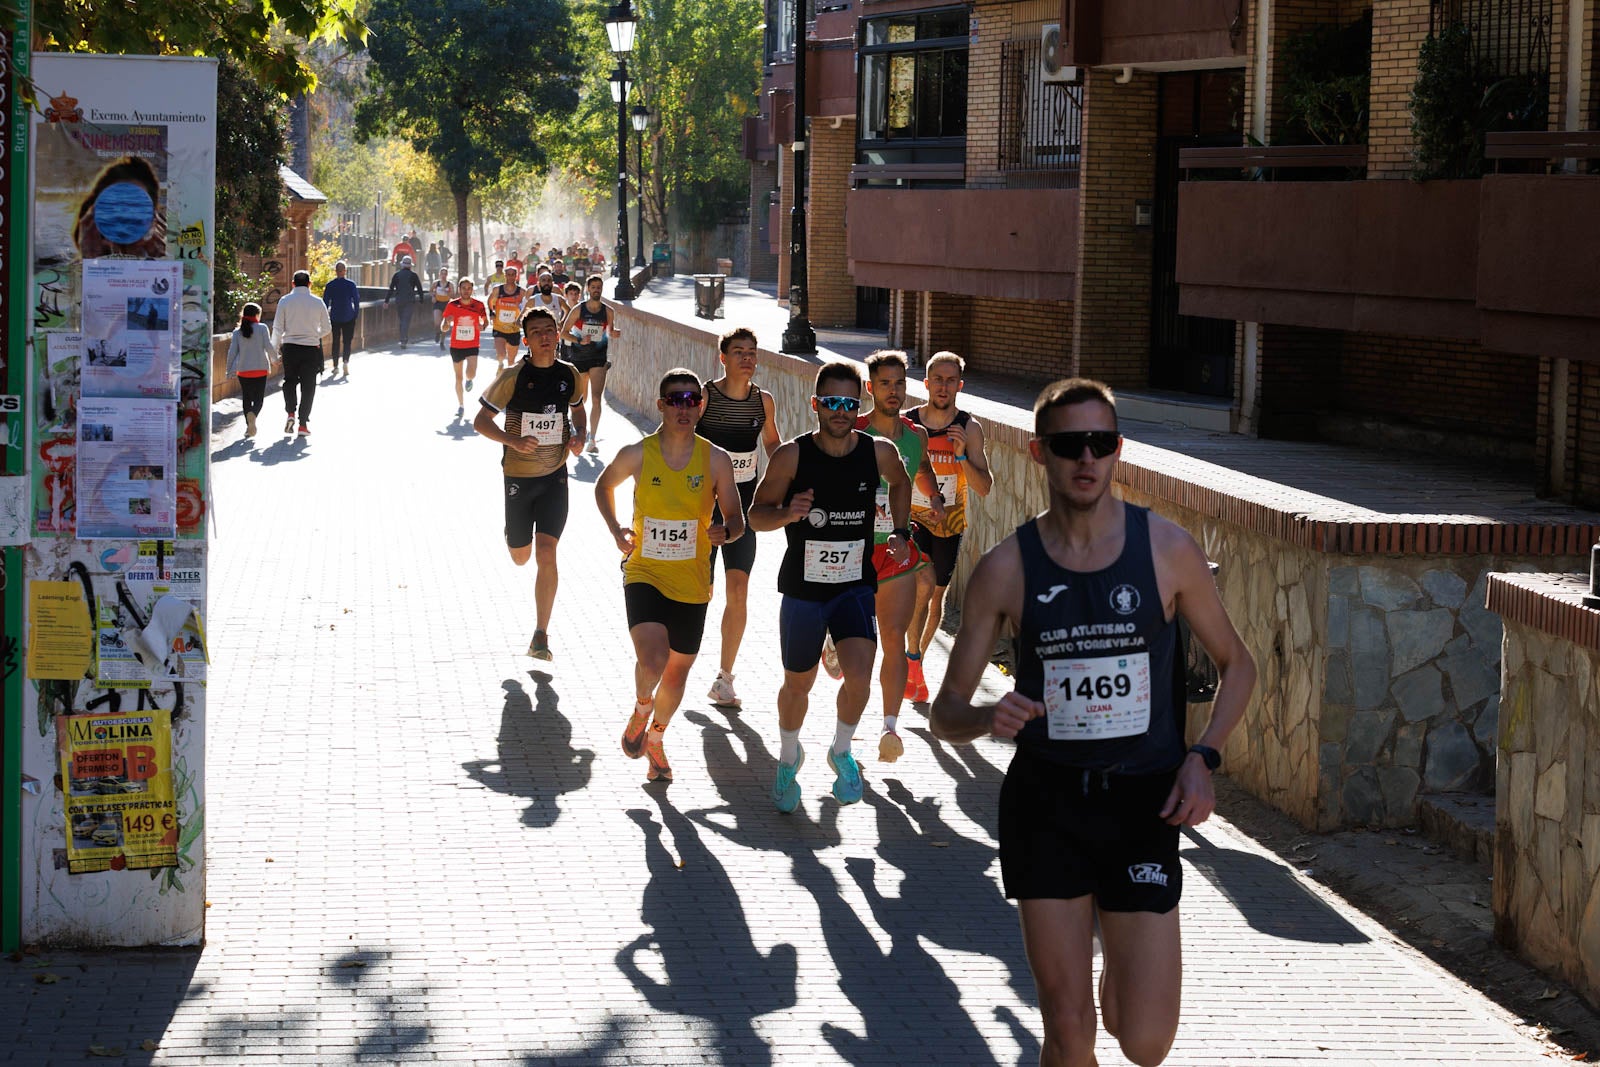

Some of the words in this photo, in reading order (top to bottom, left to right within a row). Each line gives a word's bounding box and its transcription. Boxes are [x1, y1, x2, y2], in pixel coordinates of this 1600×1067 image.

[16, 30, 27, 43] la
[18, 50, 27, 67] de
[131, 109, 206, 126] Ayuntamiento
[14, 124, 25, 152] Ruta
[191, 232, 202, 240] NO
[529, 420, 556, 430] 1497
[829, 510, 865, 520] PAUMAR
[650, 528, 688, 542] 1154
[819, 550, 850, 563] 257
[128, 571, 154, 580] OFERTA
[1040, 628, 1068, 642] CLUB
[1071, 622, 1136, 638] ATLETISMO
[1035, 642, 1074, 657] PUERTO
[1076, 636, 1145, 652] TORREVIEJA
[1059, 673, 1131, 702] 1469
[1086, 704, 1113, 713] LIZANA
[92, 717, 153, 726] AUTOESCUELAS
[74, 720, 152, 741] MOLINA
[77, 764, 119, 774] PERMISO
[127, 745, 158, 780] B
[69, 806, 84, 815] CON
[96, 803, 126, 812] CLASES
[125, 814, 154, 833] 149
[160, 813, 174, 830] €
